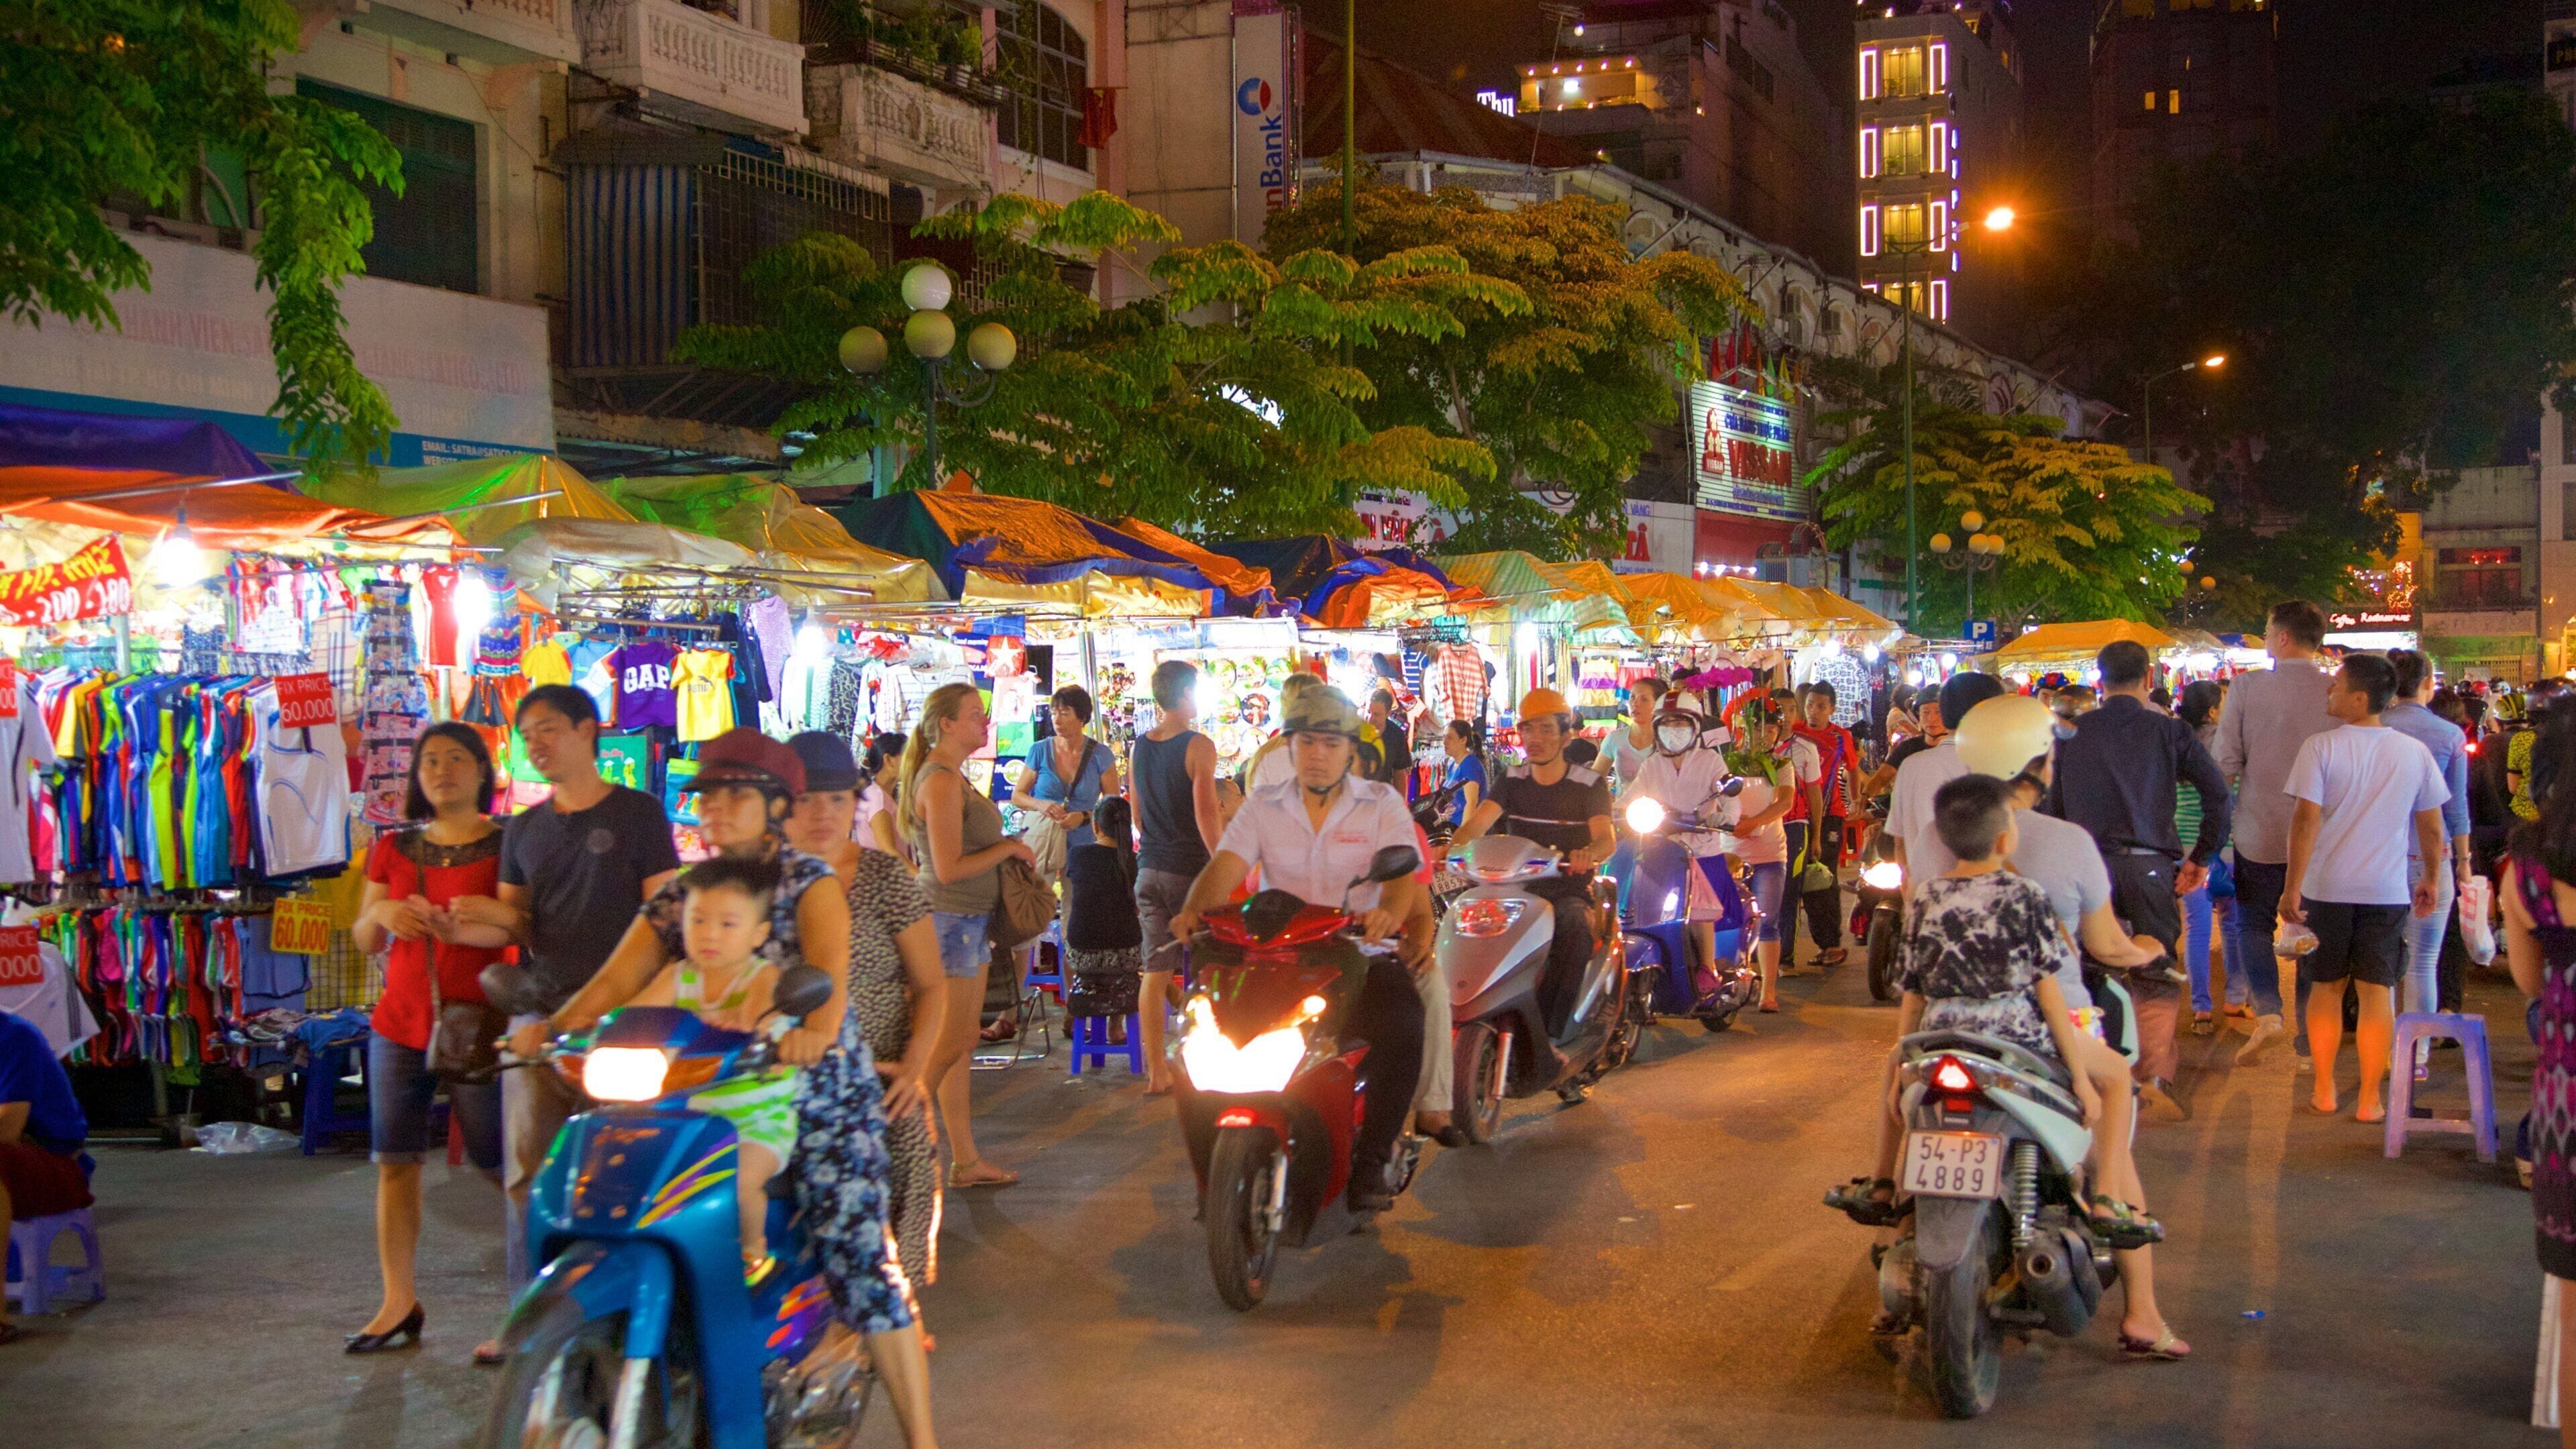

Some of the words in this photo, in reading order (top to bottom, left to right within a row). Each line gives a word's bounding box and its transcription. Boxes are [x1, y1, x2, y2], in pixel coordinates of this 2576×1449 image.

[1260, 113, 1283, 207] nBank
[1727, 439, 1792, 488] VISSAN
[1973, 623, 1987, 639] P
[277, 680, 296, 696] FIX
[297, 676, 331, 694] PRICE
[623, 663, 670, 694] GAP
[282, 698, 334, 722] 60.000
[276, 899, 293, 914] FIX
[297, 902, 332, 918] PRICE
[274, 916, 329, 951] 60.000
[1920, 1136, 1987, 1163] 54-P3
[1916, 1164, 1984, 1192] 4889
